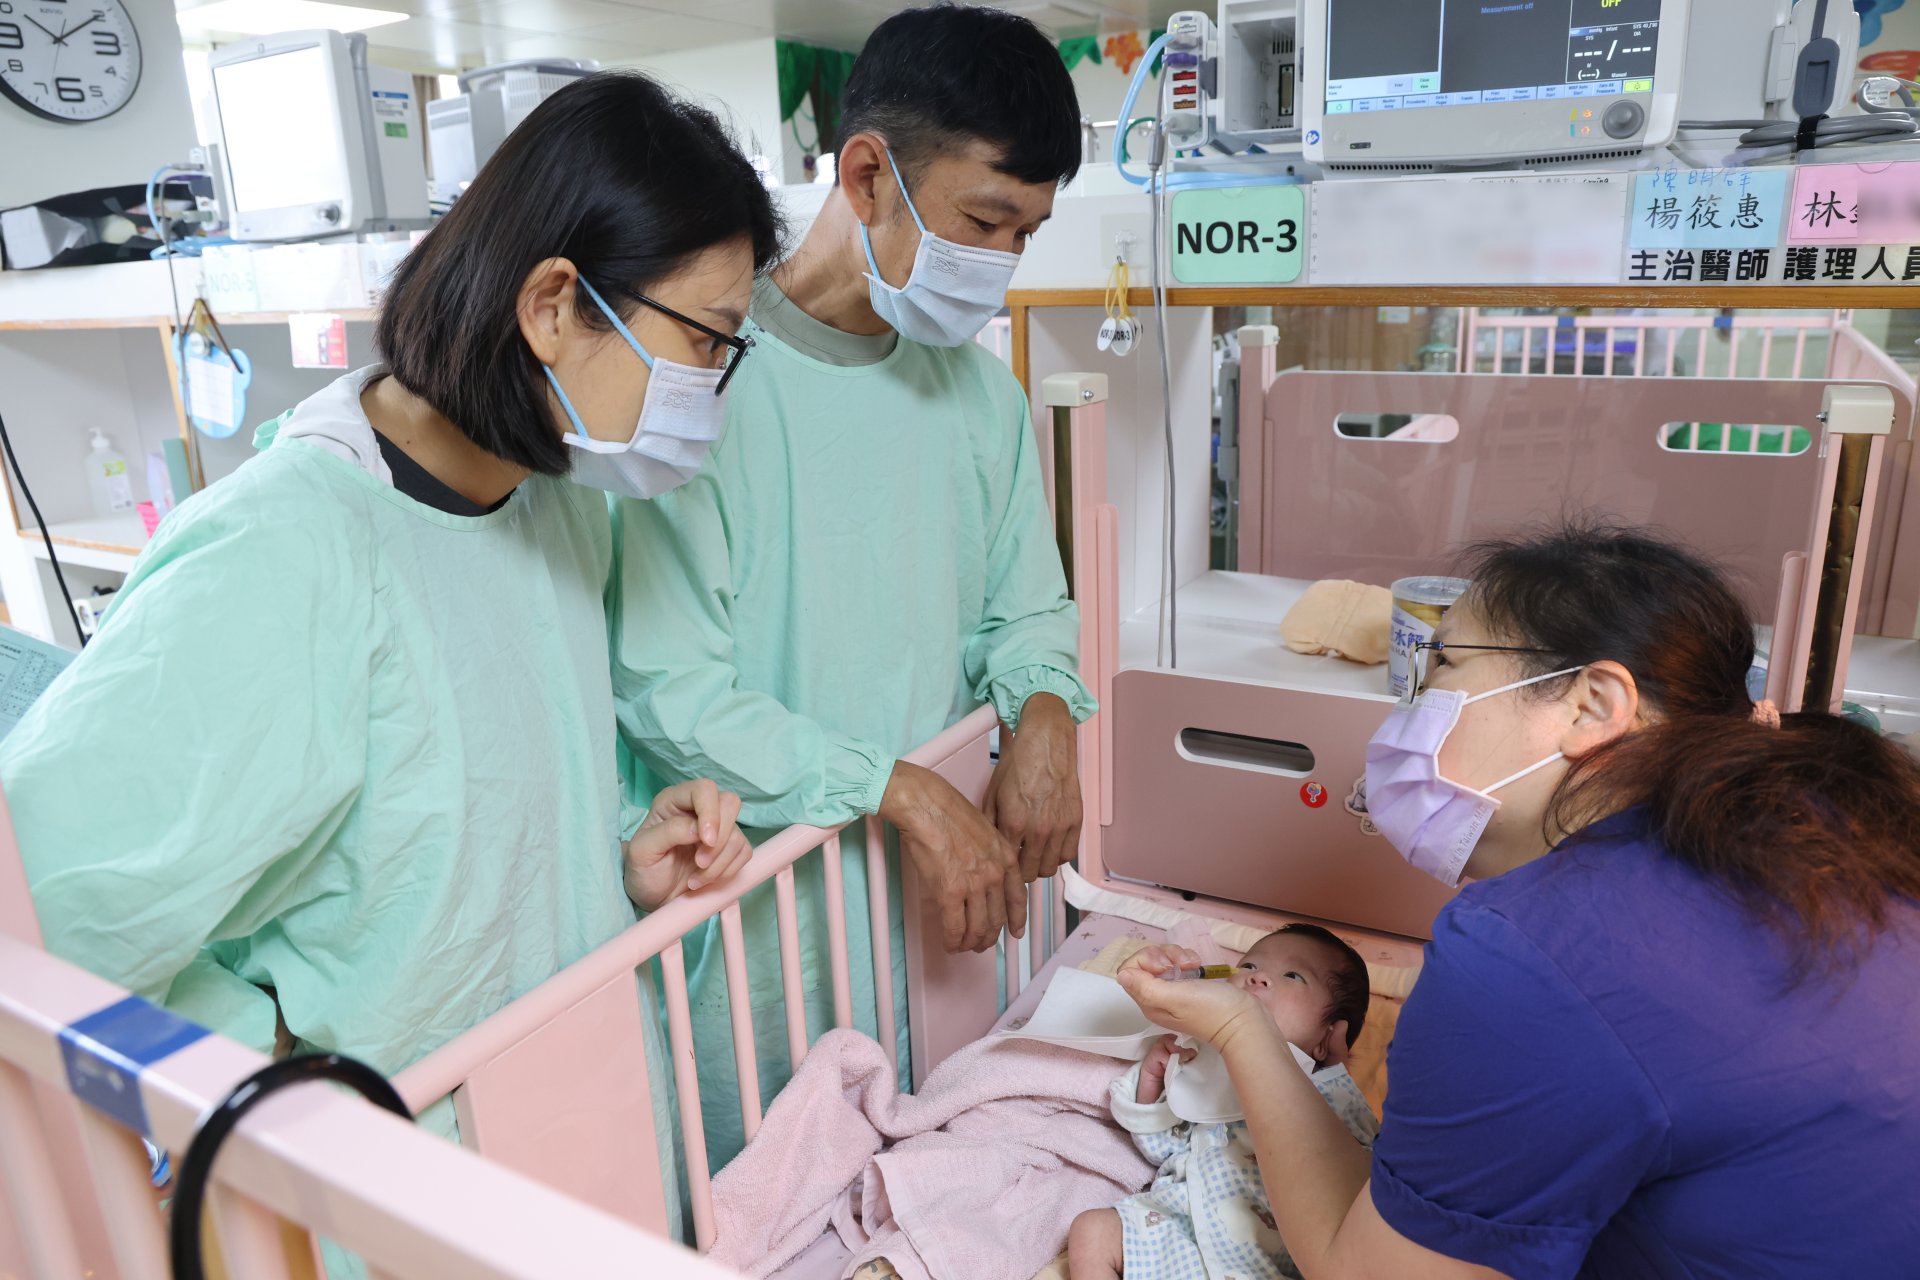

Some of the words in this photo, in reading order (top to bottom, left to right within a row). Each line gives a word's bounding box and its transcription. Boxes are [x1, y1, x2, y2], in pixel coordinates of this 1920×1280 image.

[91, 31, 122, 56] 3
[8, 59, 24, 73] 8
[104, 66, 117, 77] 4
[33, 82, 49, 95] 7
[55, 77, 86, 103] 6
[89, 85, 103, 98] 5
[1645, 192, 1764, 230] 楊筱惠
[1801, 190, 1857, 229] 林
[1177, 219, 1297, 255] NOR-3
[1628, 247, 1771, 282] 主治醫師
[1783, 246, 1920, 282] 護理人員
[1391, 628, 1425, 649] 水解
